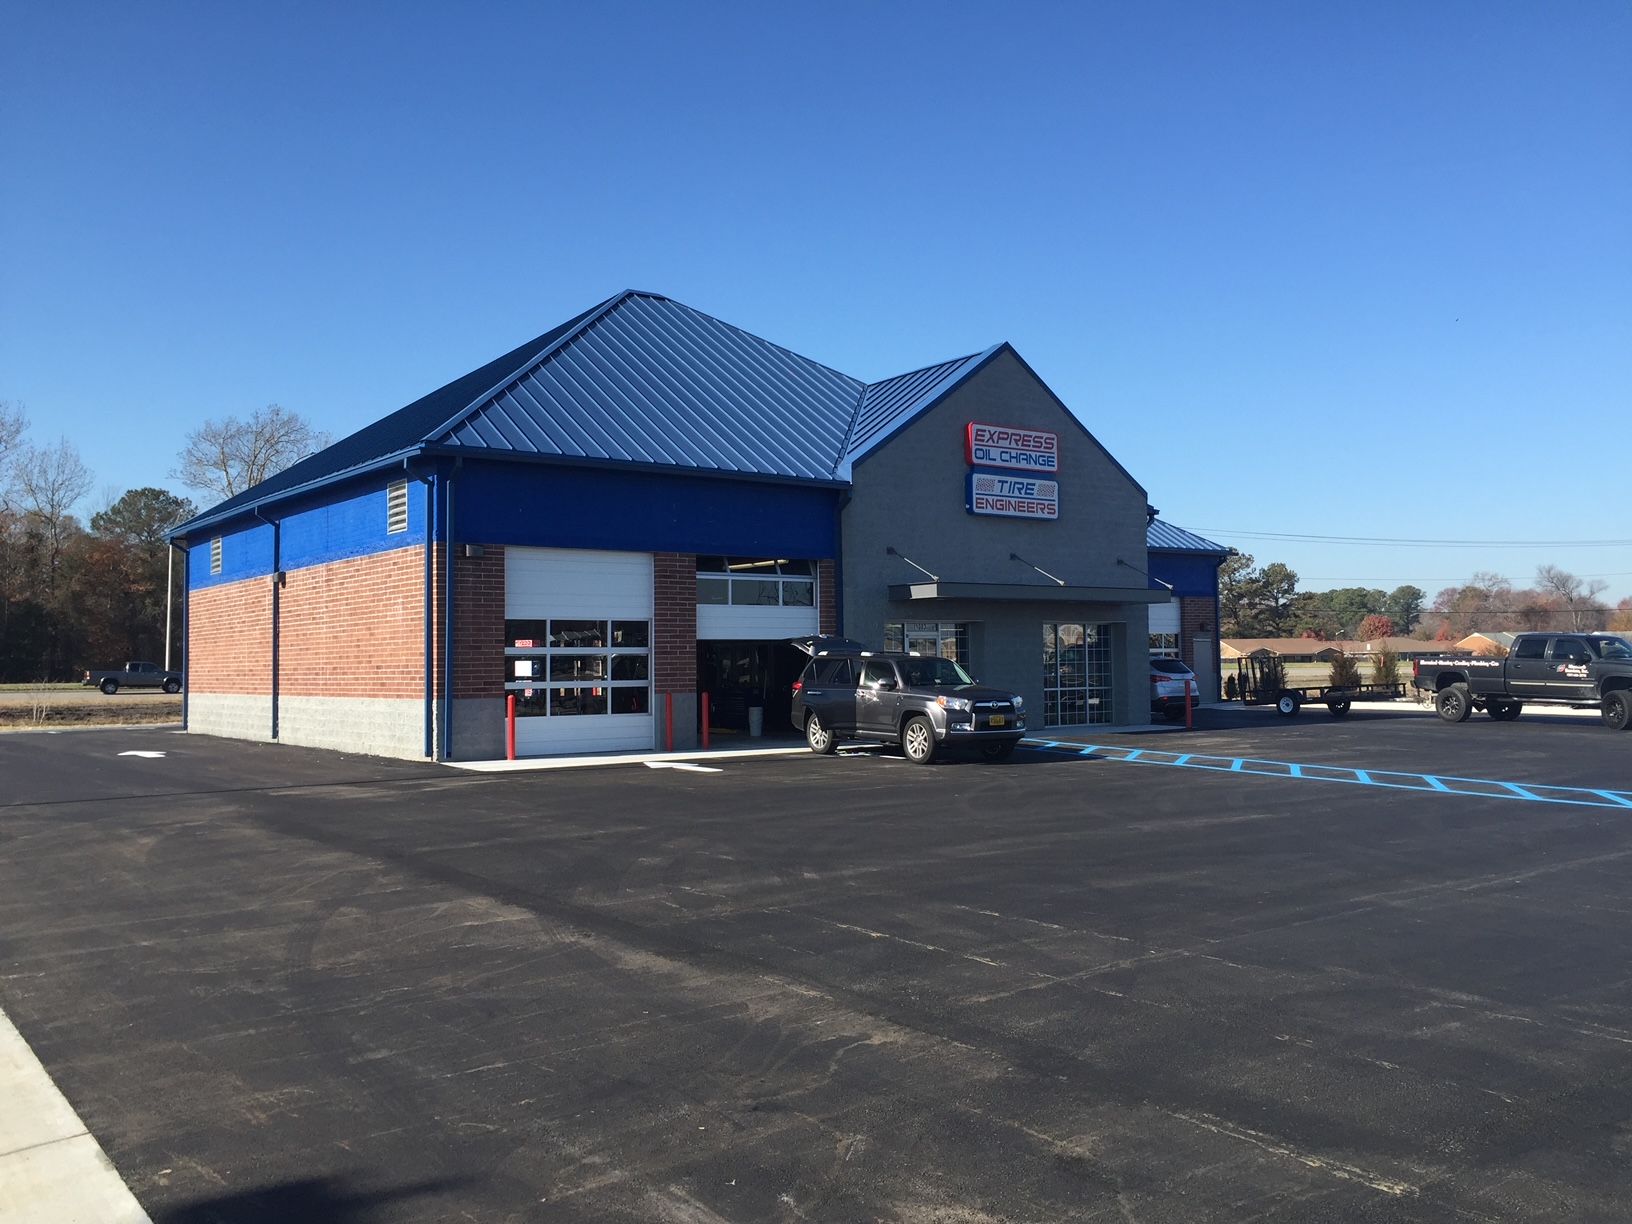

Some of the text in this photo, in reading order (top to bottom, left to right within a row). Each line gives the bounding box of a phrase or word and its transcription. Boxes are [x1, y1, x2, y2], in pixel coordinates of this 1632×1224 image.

[974, 429, 1055, 450] EXPRESS
[974, 448, 1056, 468] OIL CHANGE
[997, 479, 1036, 496] TIRE
[975, 497, 1056, 515] ENGINEERS
